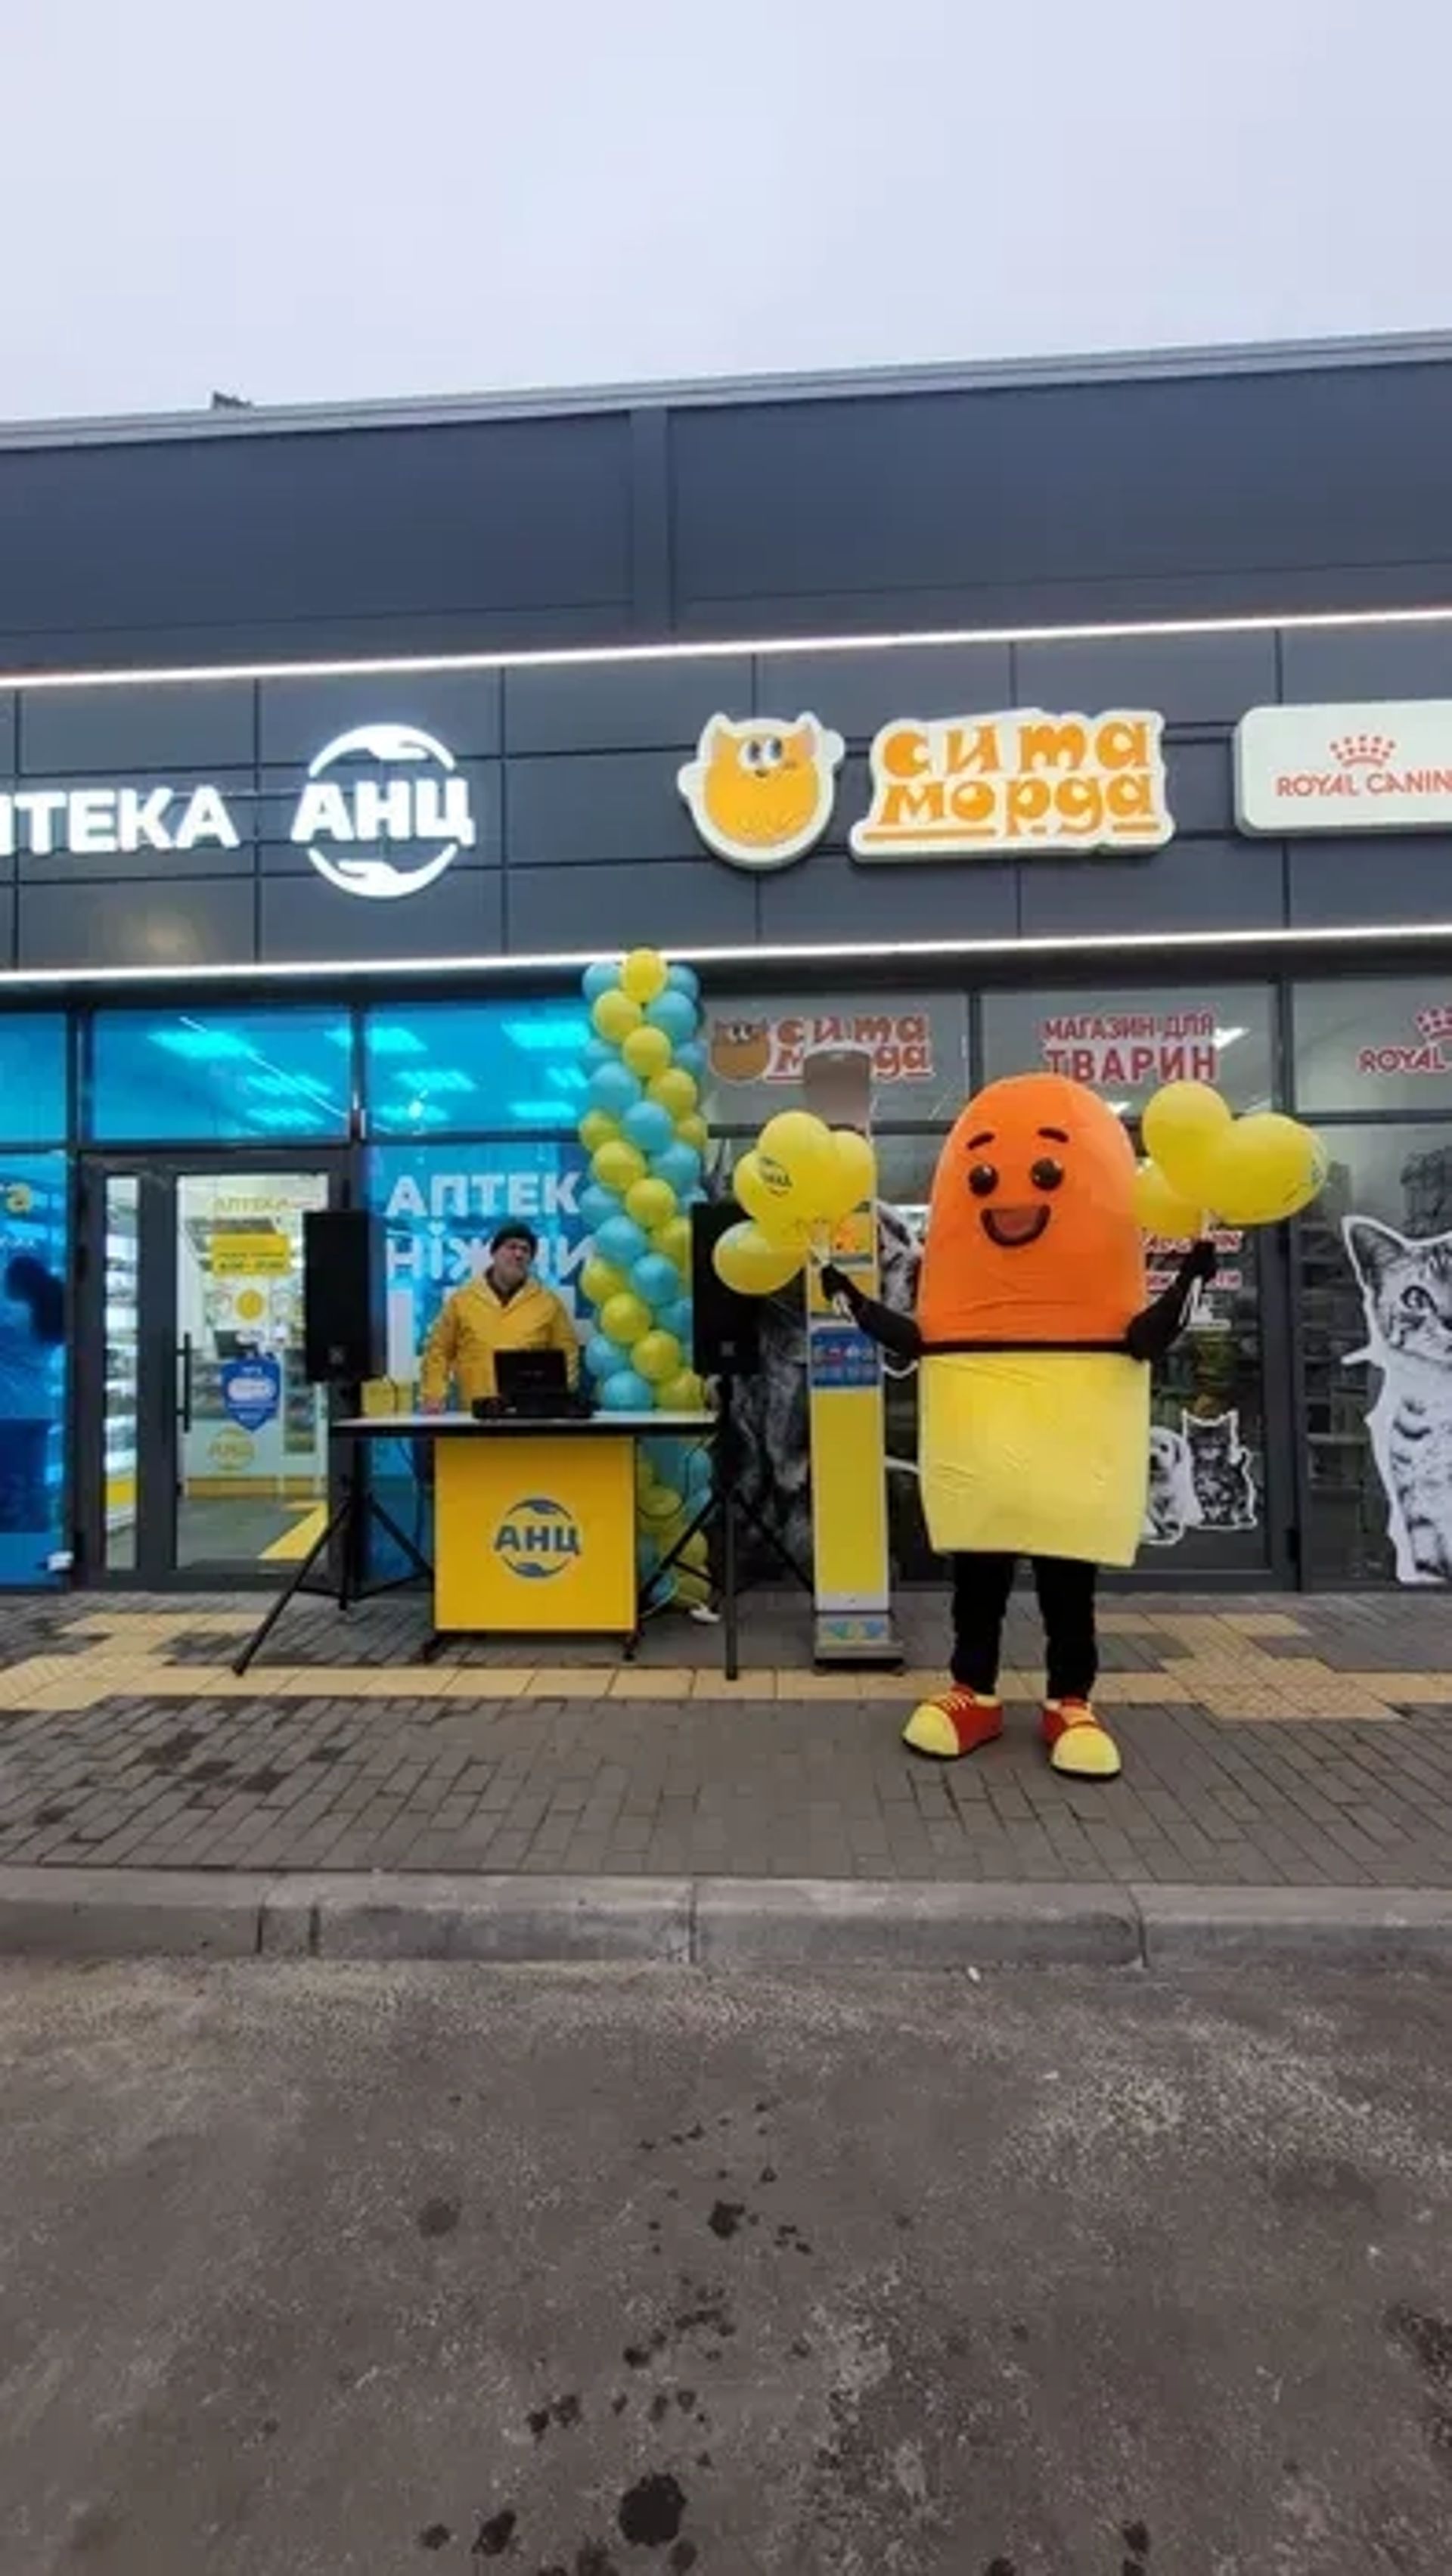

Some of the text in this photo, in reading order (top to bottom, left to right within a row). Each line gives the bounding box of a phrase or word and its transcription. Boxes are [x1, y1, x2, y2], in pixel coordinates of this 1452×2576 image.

[1277, 769, 1452, 796] ROYAL CANIN
[290, 777, 476, 846] АНЦ
[1046, 1013, 1215, 1040] МАГАЗИН ДЛЯ
[774, 1044, 931, 1077] мда
[1046, 1046, 1217, 1082] ТВАРИН
[1358, 1047, 1445, 1072] ROYAL
[493, 1525, 581, 1556] АНЦ
